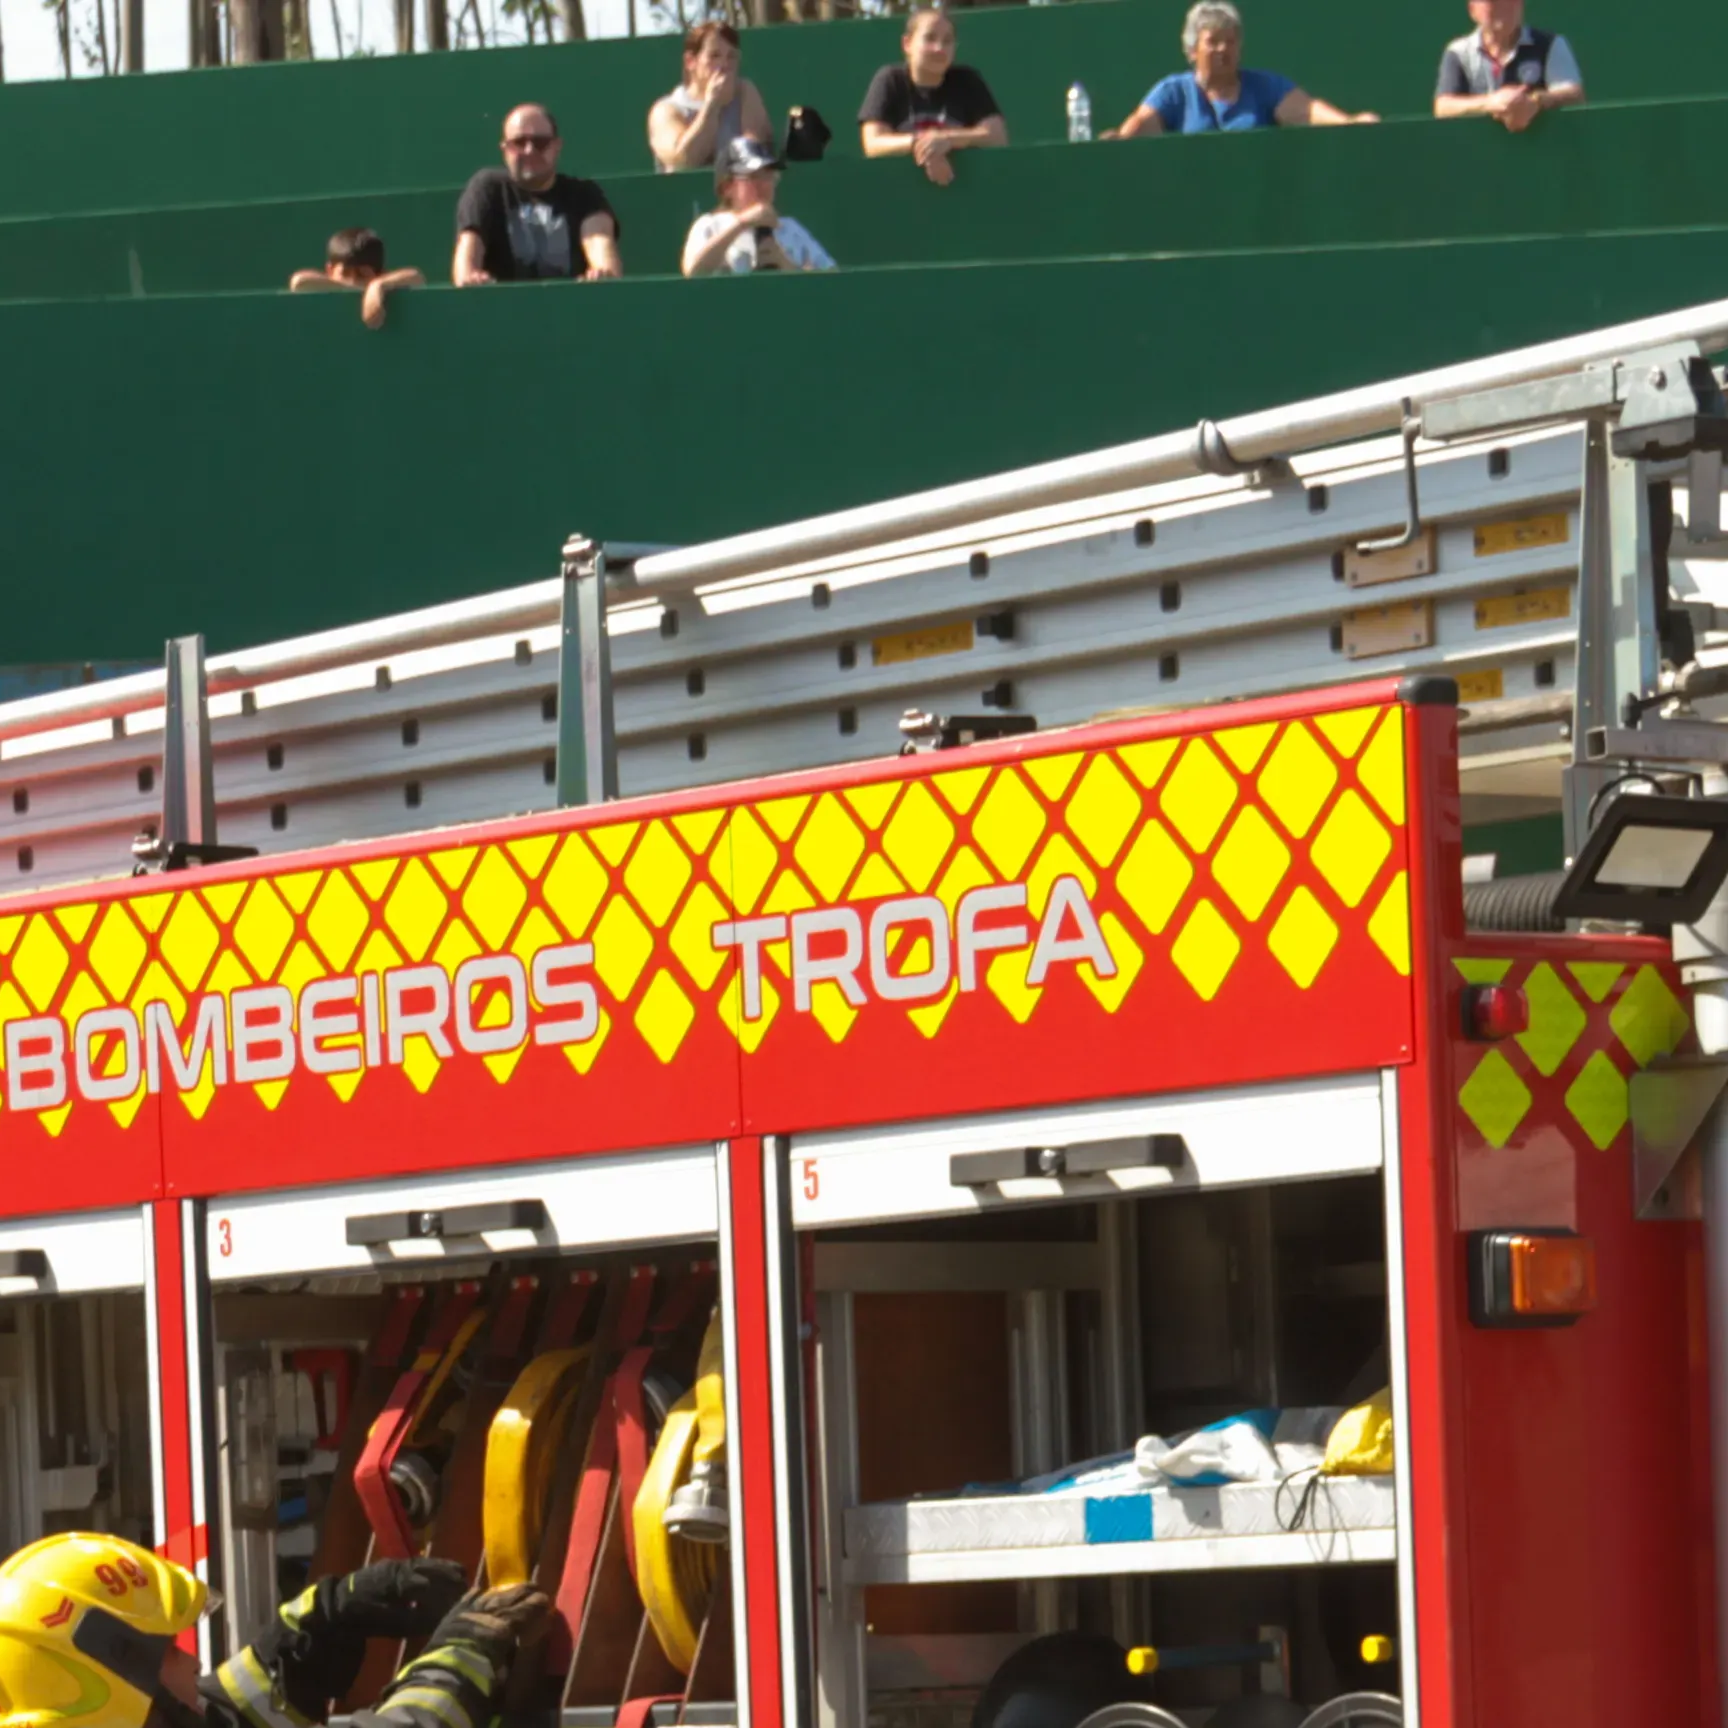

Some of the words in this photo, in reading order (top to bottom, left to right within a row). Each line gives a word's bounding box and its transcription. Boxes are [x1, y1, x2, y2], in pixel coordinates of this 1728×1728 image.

[2, 939, 601, 1114] BOMBEIROS
[711, 875, 1119, 1022] TROFA
[802, 1158, 821, 1202] 5
[218, 1217, 234, 1259] 3
